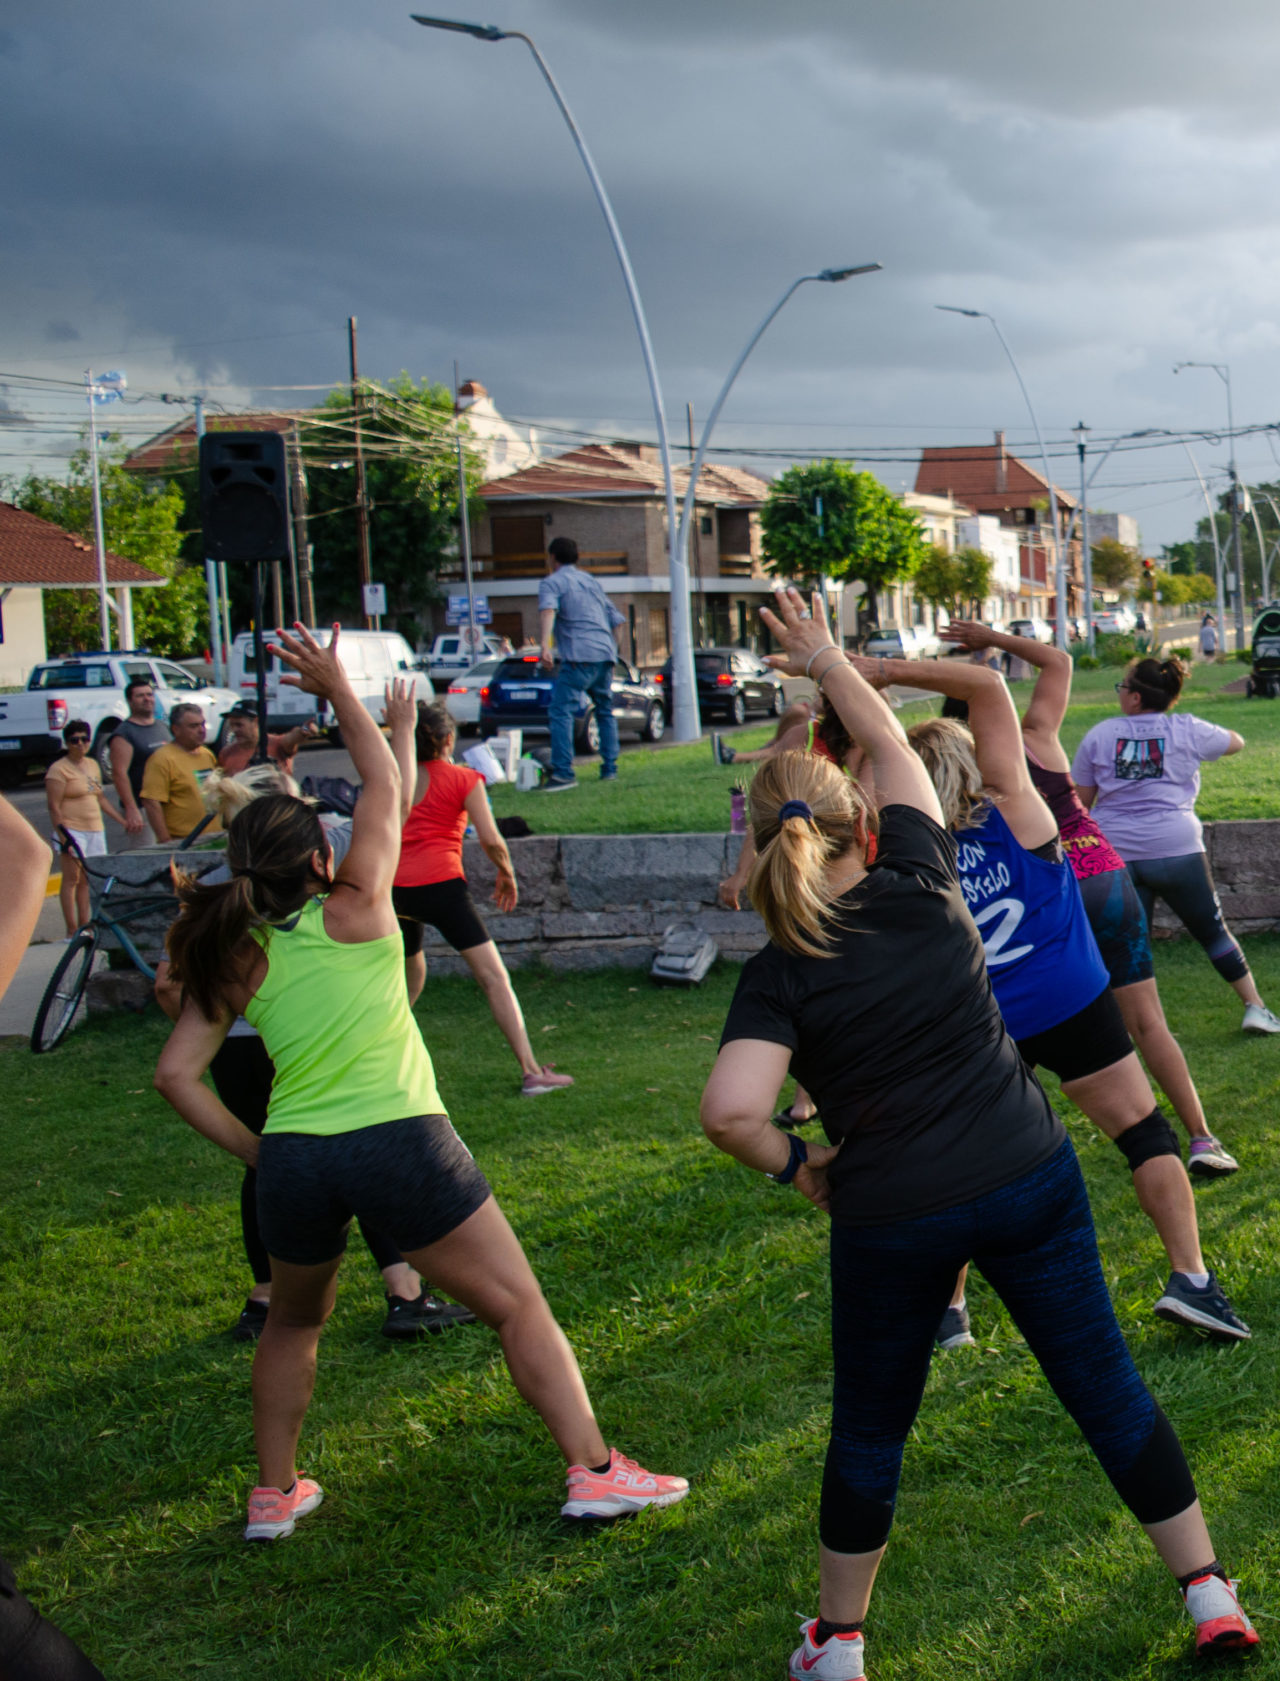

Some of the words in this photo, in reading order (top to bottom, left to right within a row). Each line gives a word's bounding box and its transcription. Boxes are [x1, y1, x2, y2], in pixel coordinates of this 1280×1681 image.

[957, 841, 986, 872] CON
[960, 862, 1010, 905] STILO
[974, 898, 1034, 966] 2
[613, 1470, 658, 1489] FILA
